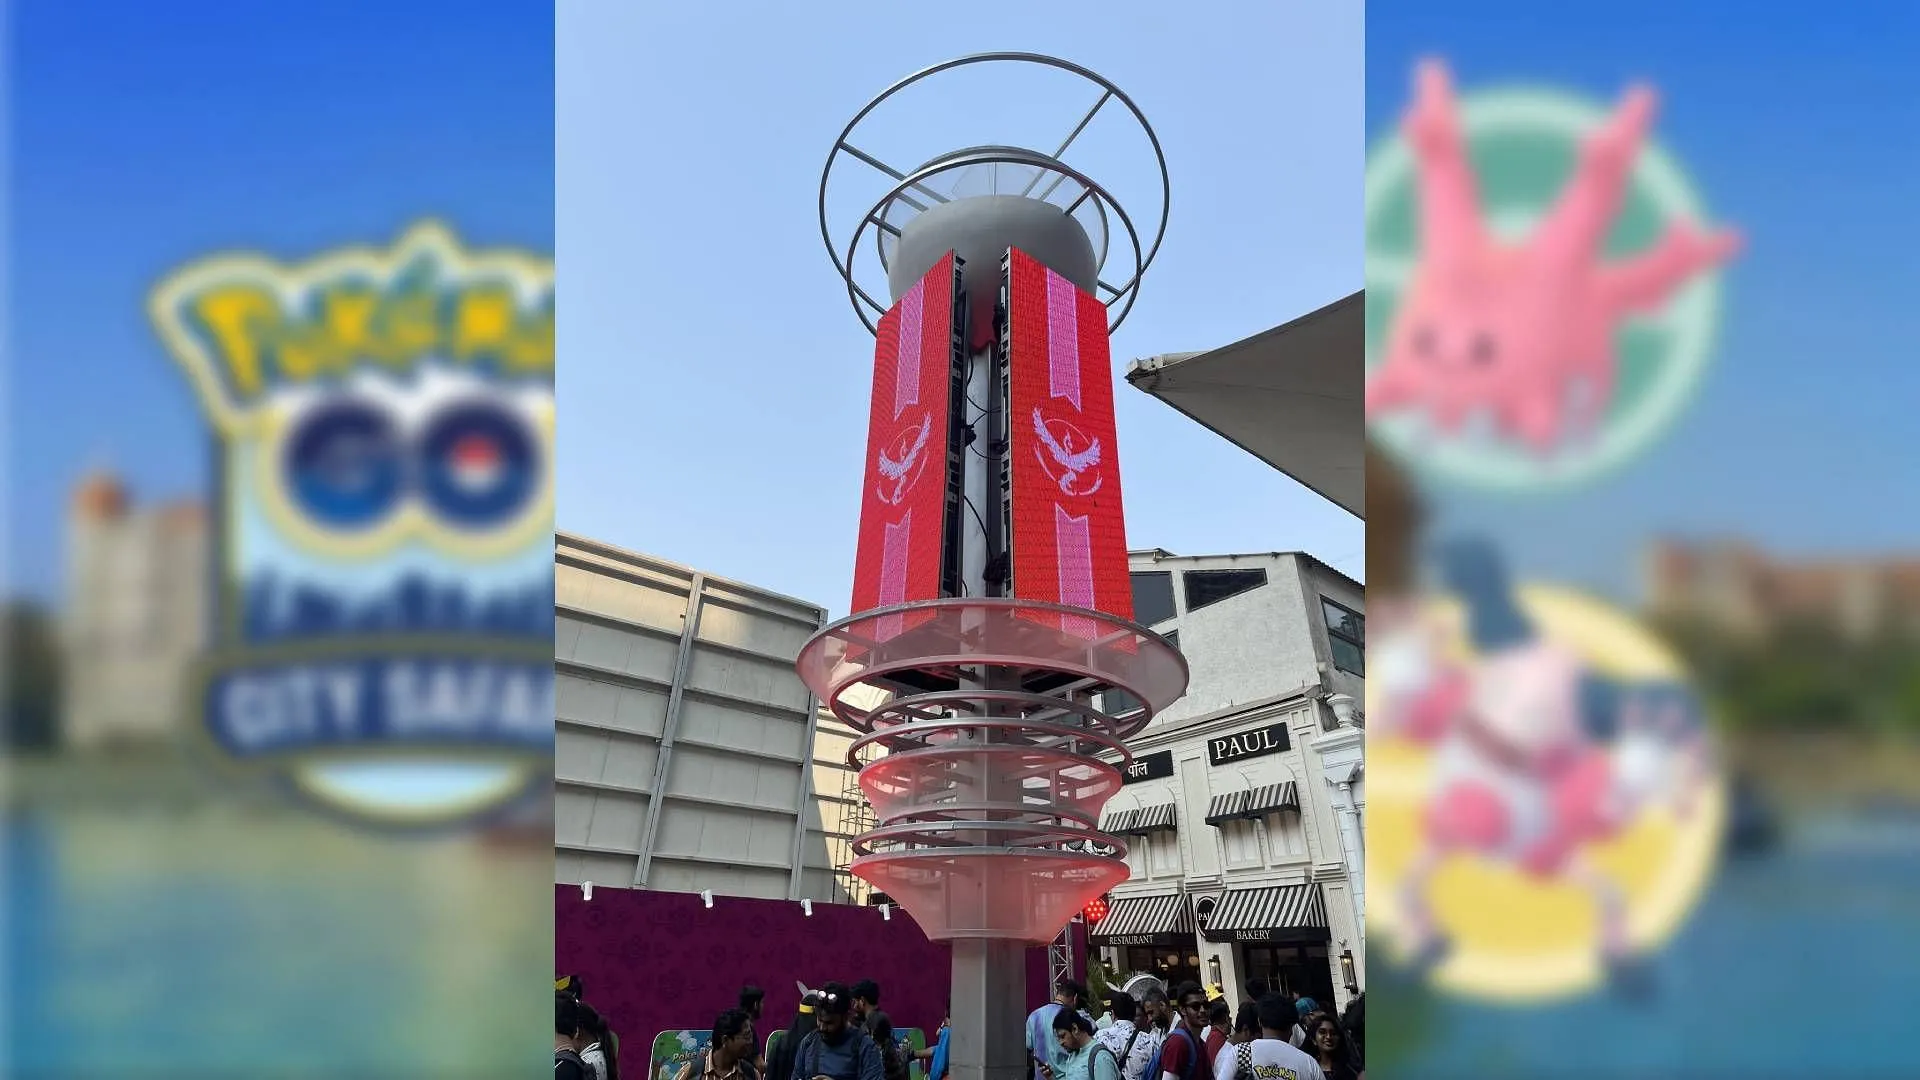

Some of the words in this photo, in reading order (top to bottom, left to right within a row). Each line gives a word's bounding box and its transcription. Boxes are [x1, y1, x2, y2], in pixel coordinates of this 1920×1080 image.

[1213, 729, 1279, 760] PAUL
[1109, 934, 1154, 945] RESTAURANT
[1236, 929, 1271, 940] BAKERY
